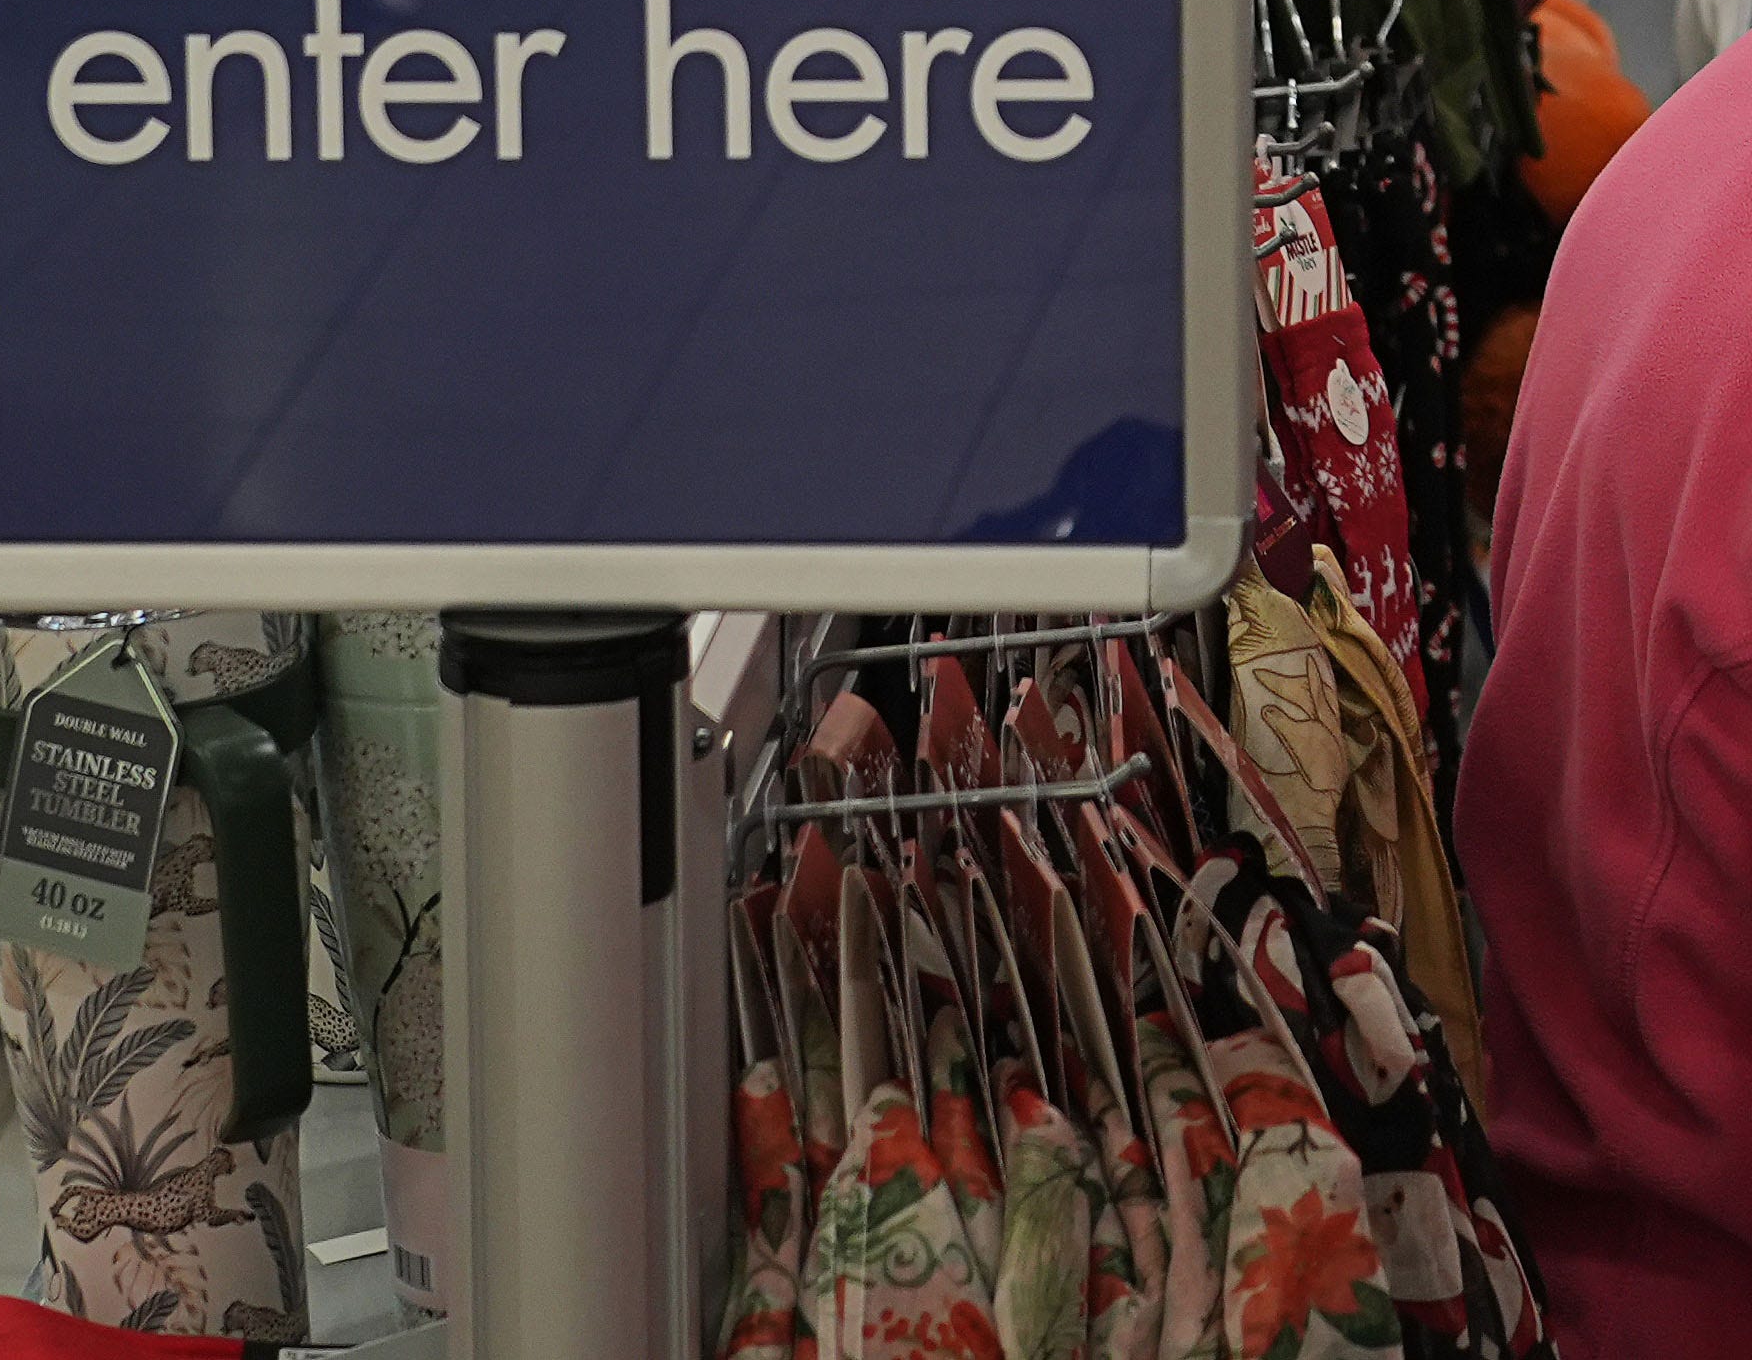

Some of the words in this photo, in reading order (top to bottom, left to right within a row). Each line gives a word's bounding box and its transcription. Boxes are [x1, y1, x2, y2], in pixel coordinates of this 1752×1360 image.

[54, 712, 108, 739] DOUBLE
[108, 725, 148, 749] WALL
[31, 739, 158, 791] STAINLESS
[54, 768, 125, 807] STEEL
[30, 787, 142, 837] TUMBLER
[32, 877, 67, 910] 40
